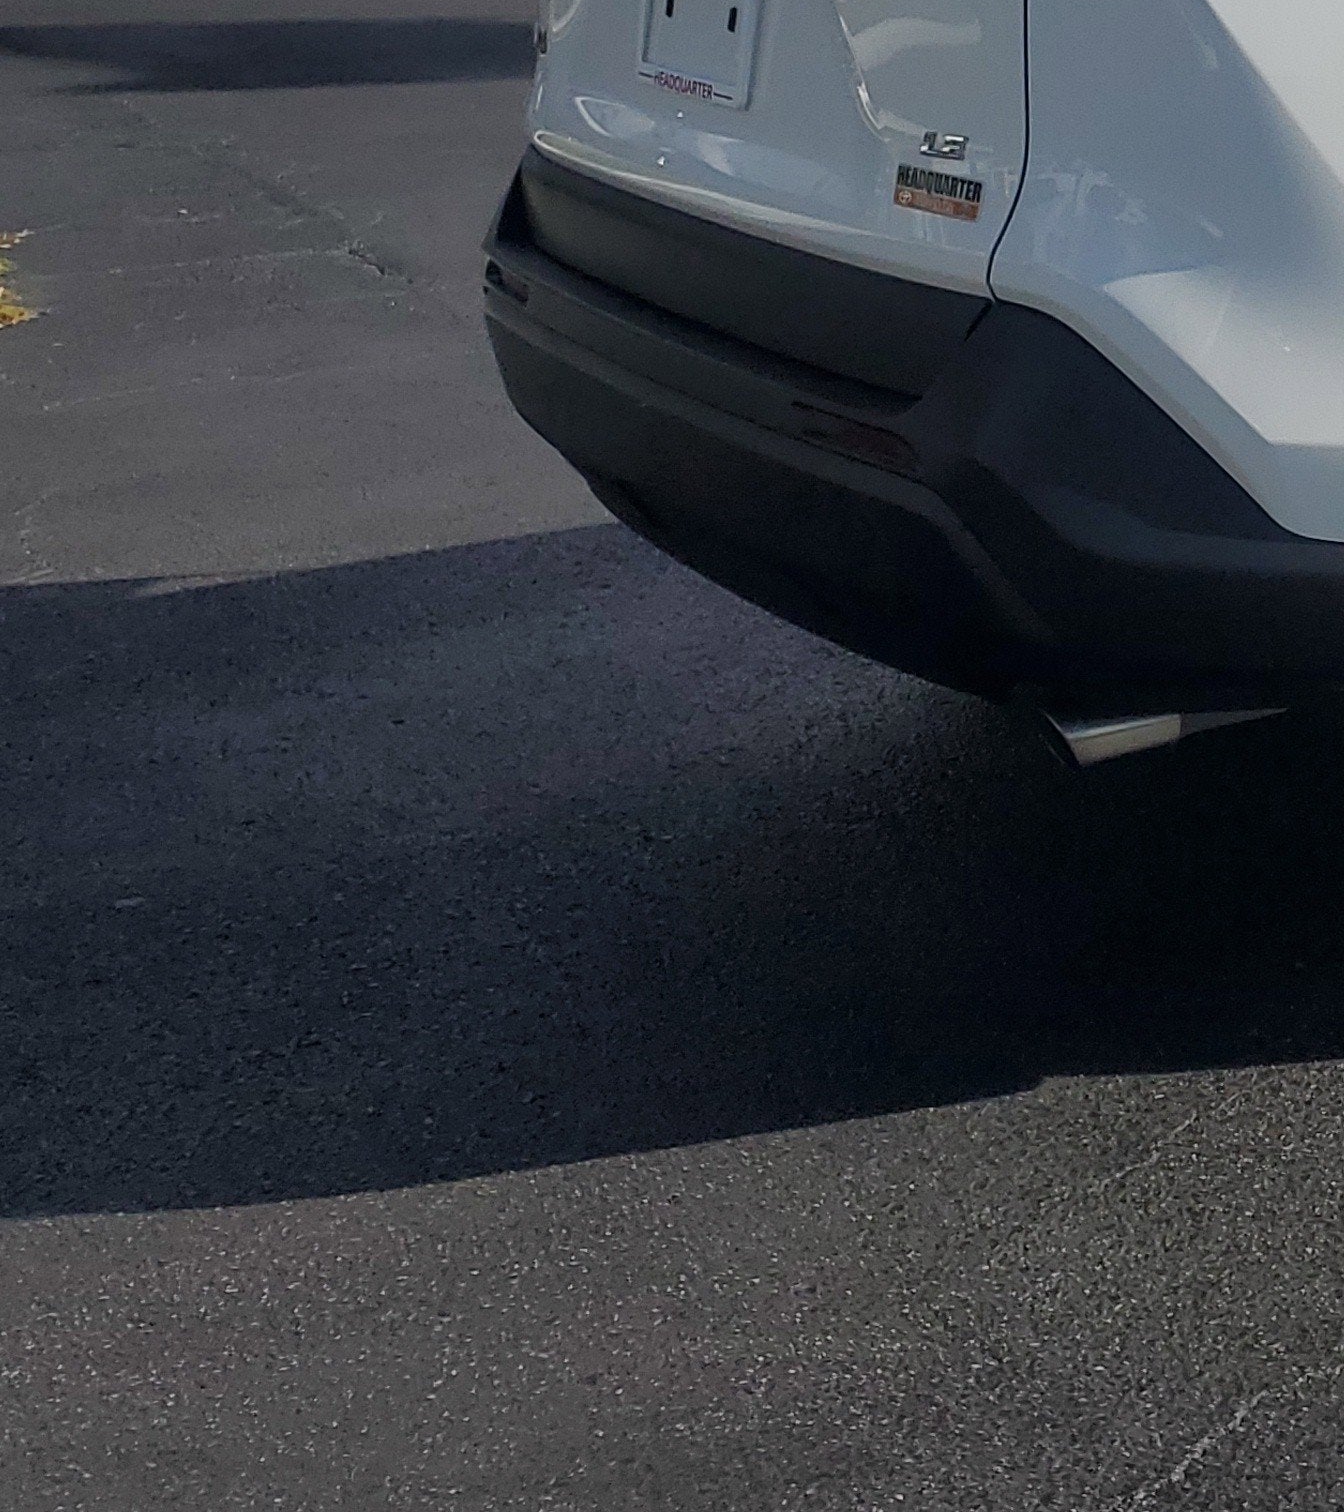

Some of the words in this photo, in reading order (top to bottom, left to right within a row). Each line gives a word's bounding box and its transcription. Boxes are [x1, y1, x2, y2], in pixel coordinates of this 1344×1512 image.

[654, 71, 713, 100] HEADQUARTER
[920, 131, 969, 161] LE
[897, 163, 982, 203] HEADQUARTER
